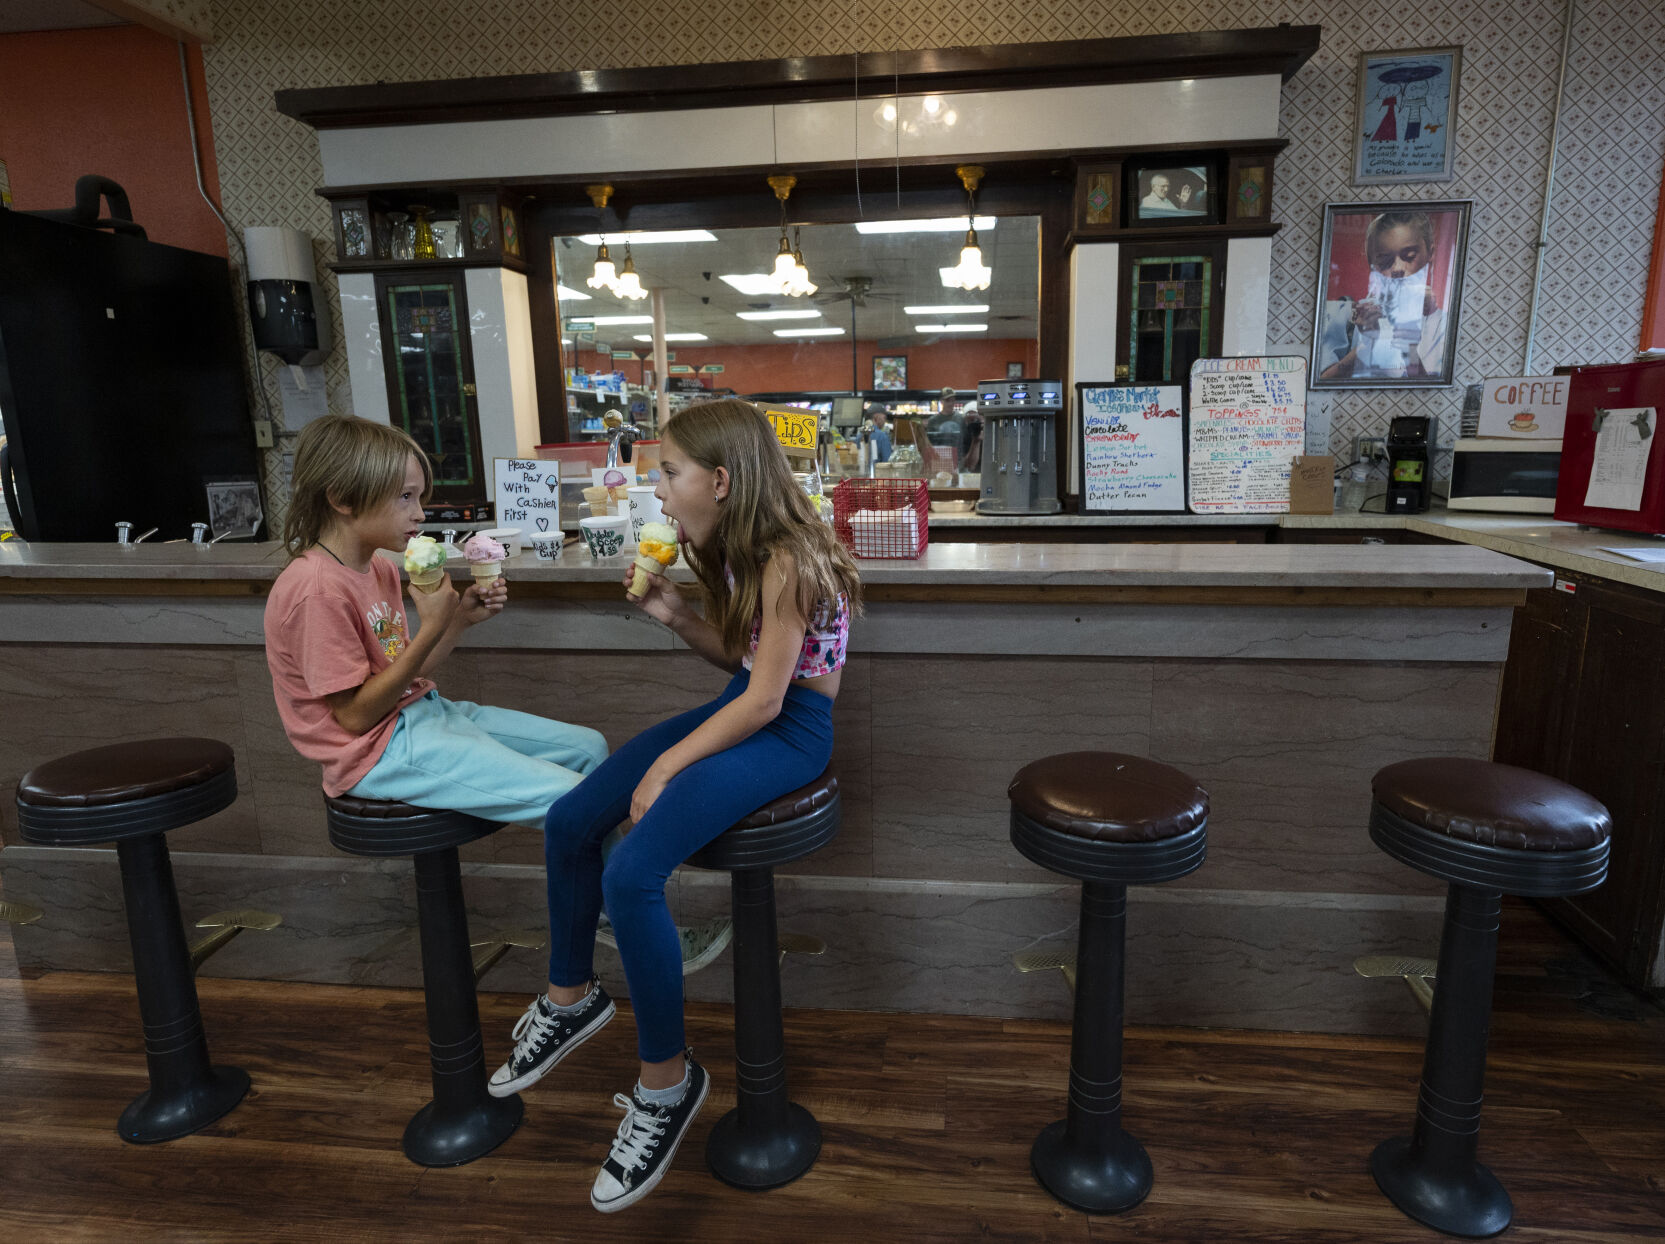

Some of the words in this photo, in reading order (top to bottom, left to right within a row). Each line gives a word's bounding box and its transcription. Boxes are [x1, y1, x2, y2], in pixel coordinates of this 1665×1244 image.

[1226, 358, 1261, 371] CREAM
[1266, 358, 1294, 371] MENU
[1494, 382, 1564, 405] COFFEE
[508, 459, 537, 471] Please
[523, 472, 543, 483] Pay
[503, 482, 530, 493] With
[1087, 483, 1115, 492] Mocha
[1123, 490, 1147, 499] Pecan
[504, 508, 528, 521] First
